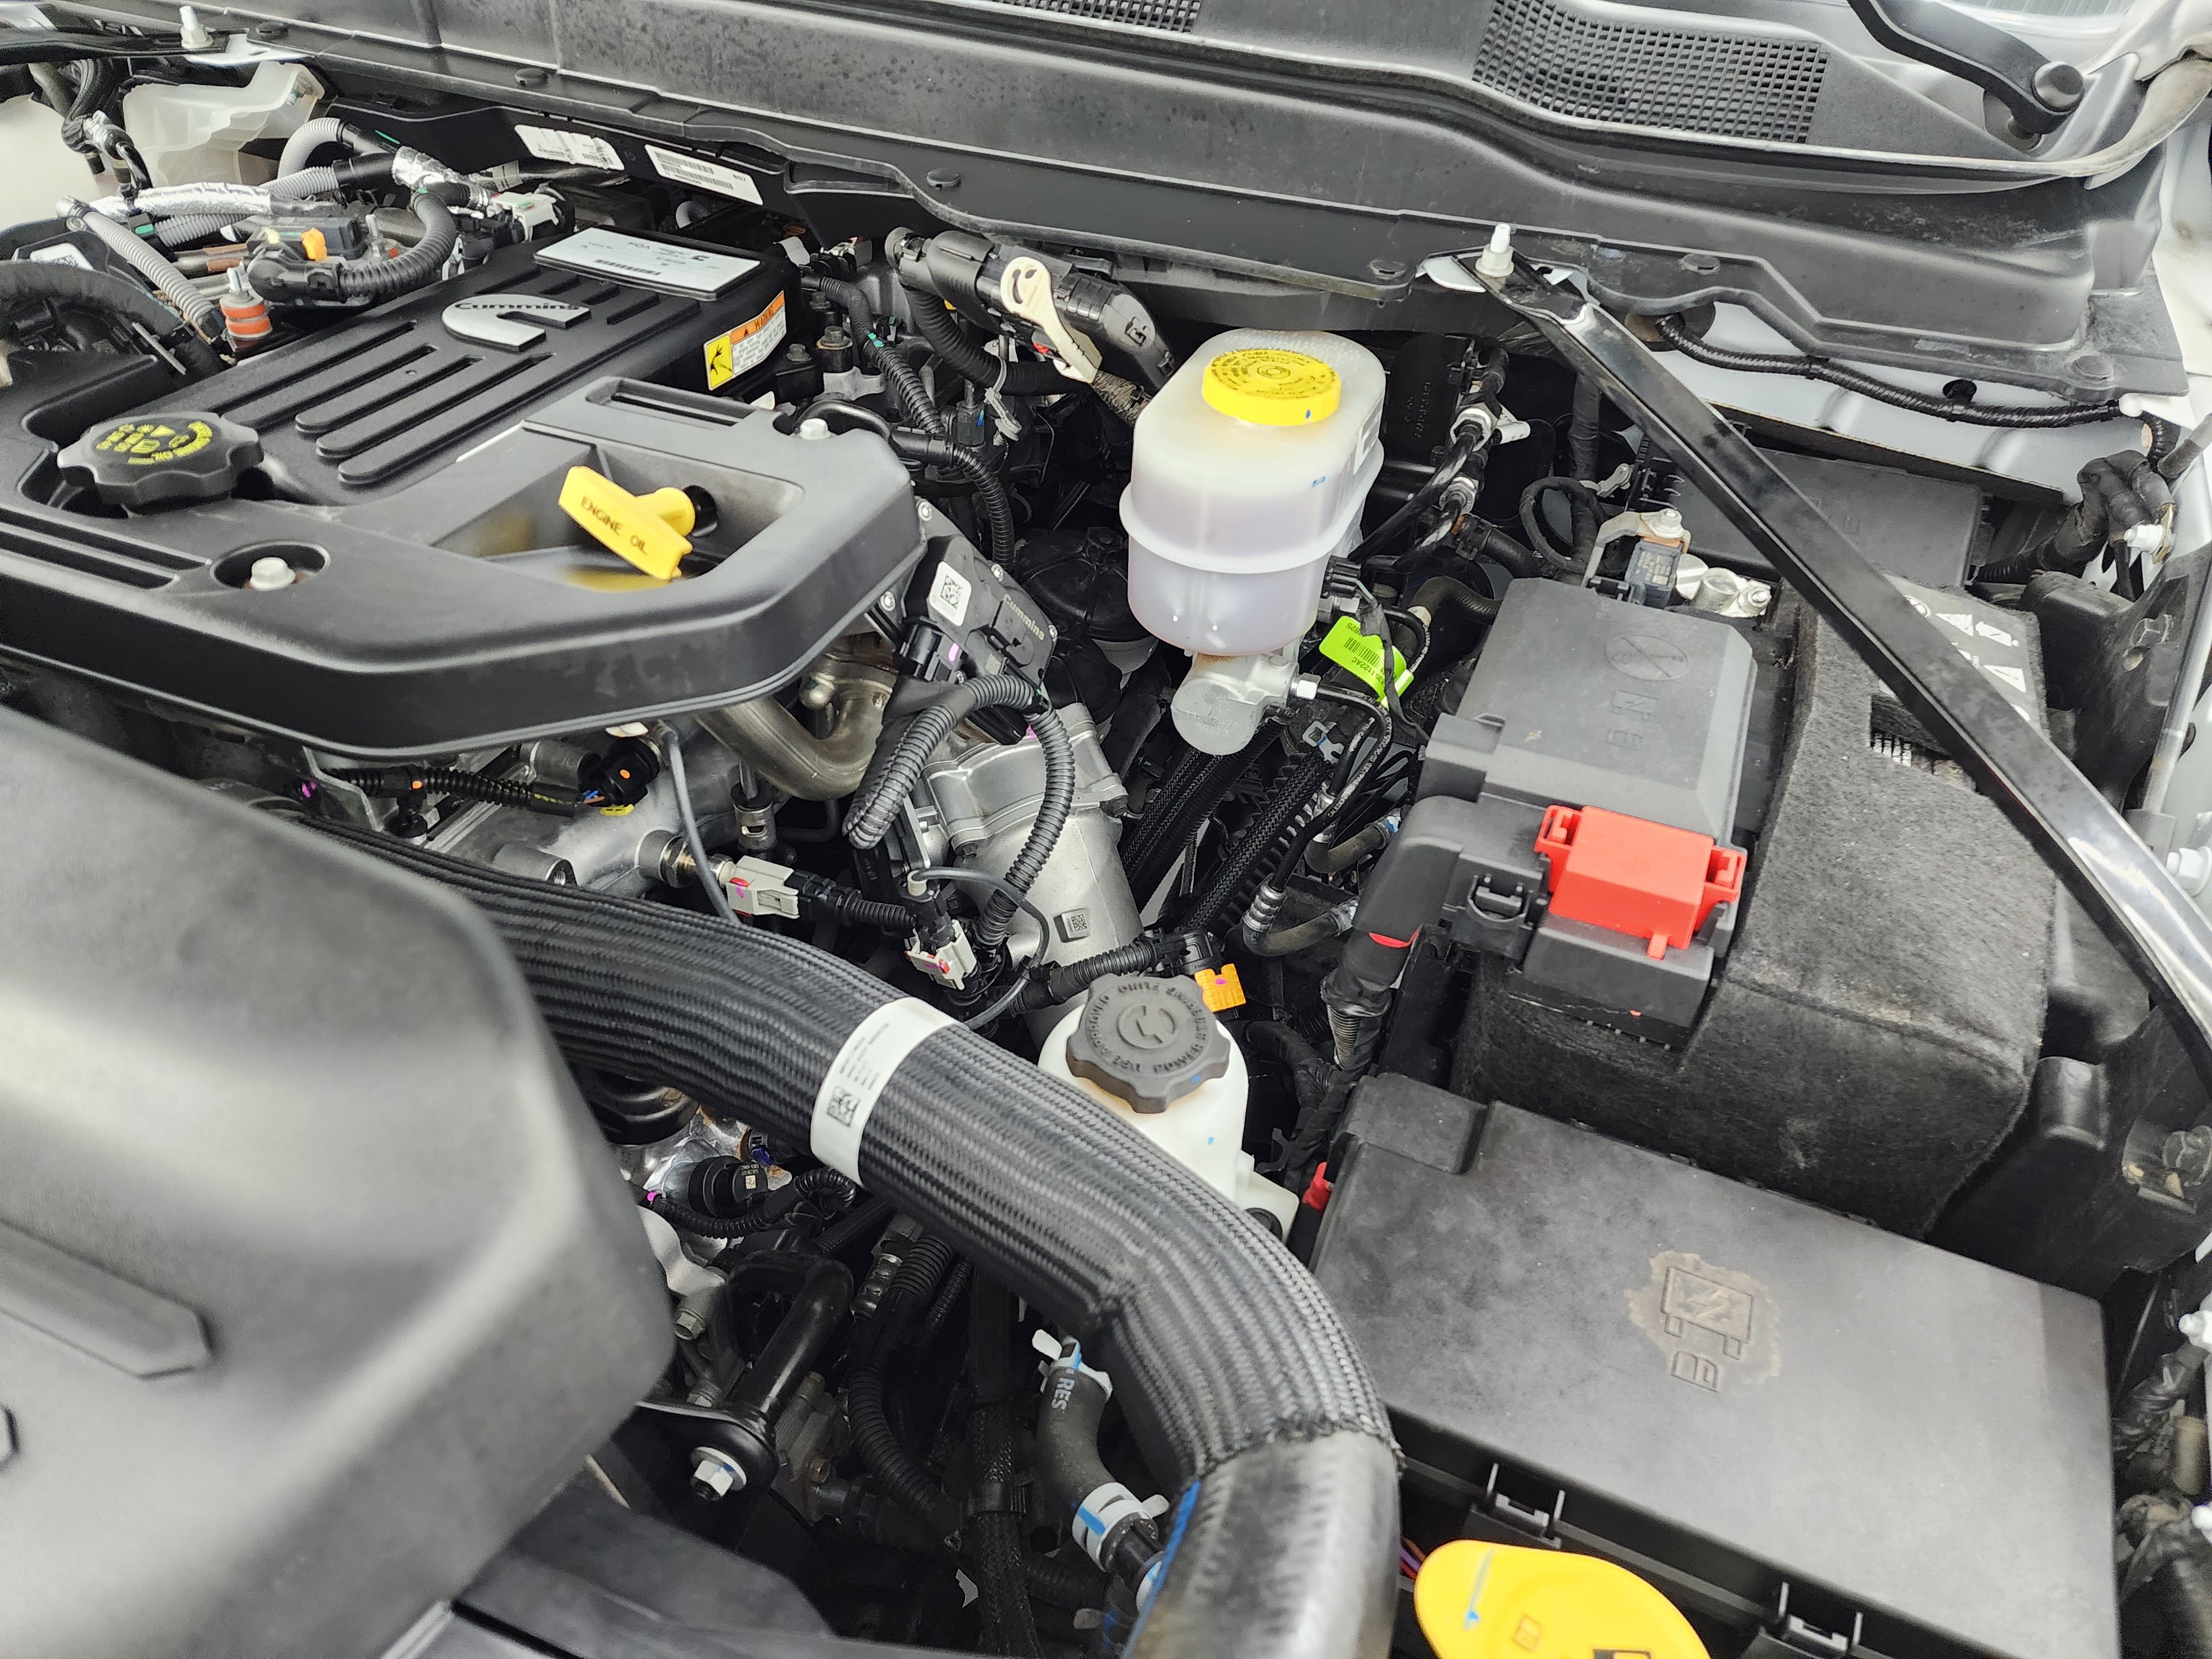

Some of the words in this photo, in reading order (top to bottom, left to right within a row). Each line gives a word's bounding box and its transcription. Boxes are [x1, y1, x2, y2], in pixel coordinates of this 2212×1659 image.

[581, 495, 623, 536] ENGINE
[629, 534, 649, 555] OIL
[1003, 593, 1045, 640] Cummins
[1051, 1377, 1076, 1411] RES
